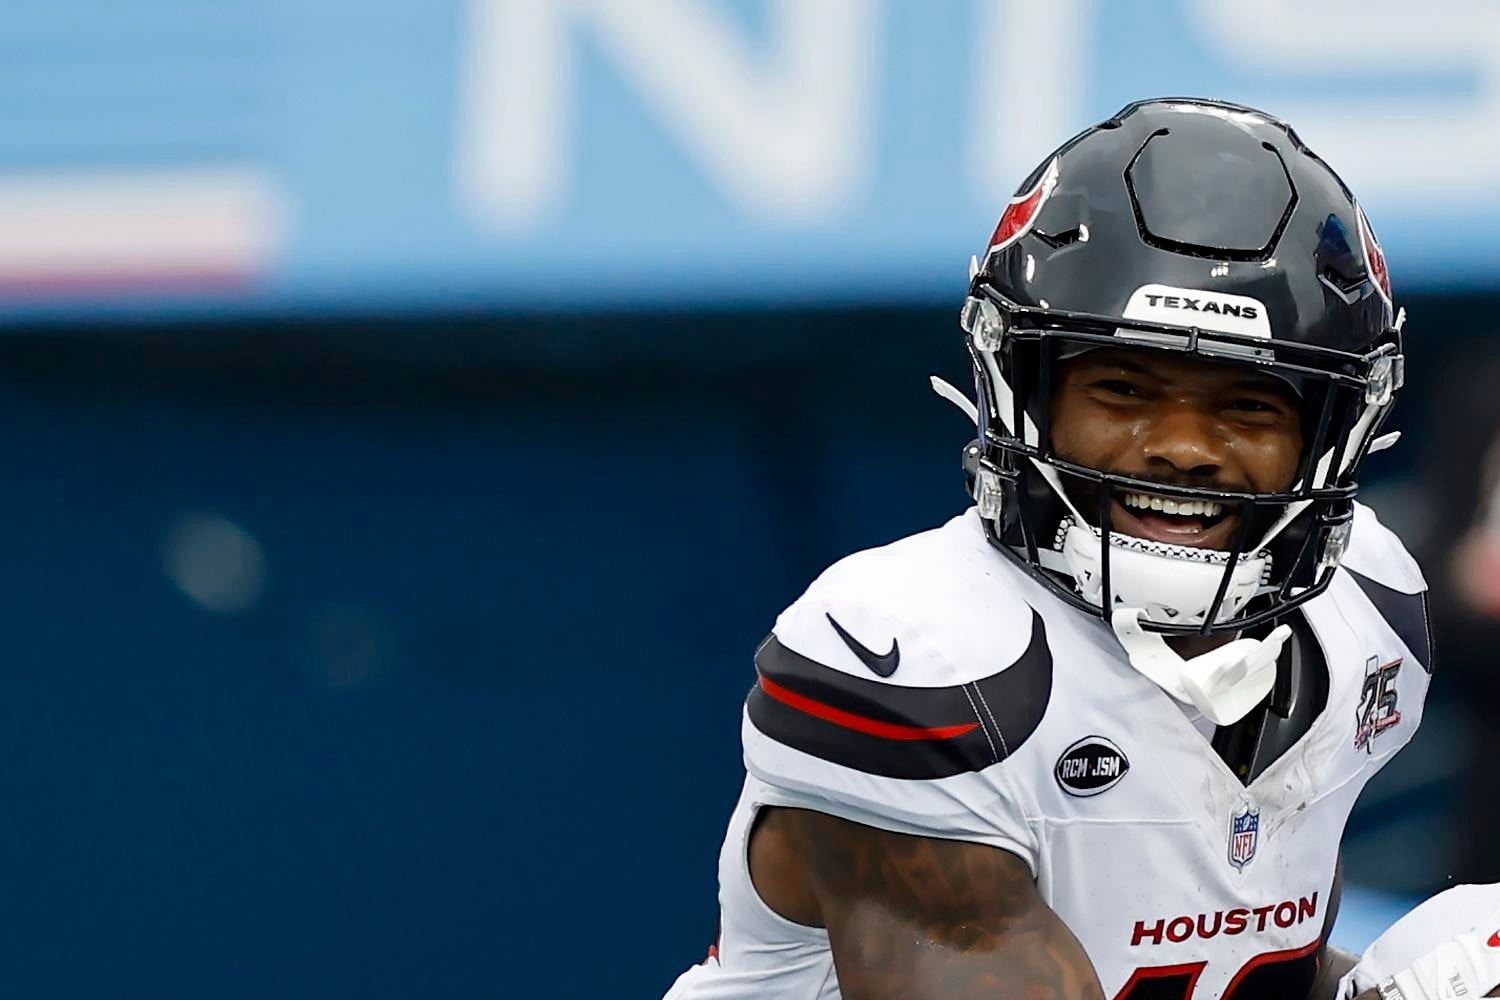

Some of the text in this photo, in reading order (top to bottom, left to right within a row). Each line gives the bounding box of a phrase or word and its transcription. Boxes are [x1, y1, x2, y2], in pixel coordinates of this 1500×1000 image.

[1144, 294, 1258, 320] TEXANS
[1062, 756, 1121, 779] RCM JSM
[1233, 832, 1256, 860] NFL
[1130, 891, 1319, 946] HOUSTON
